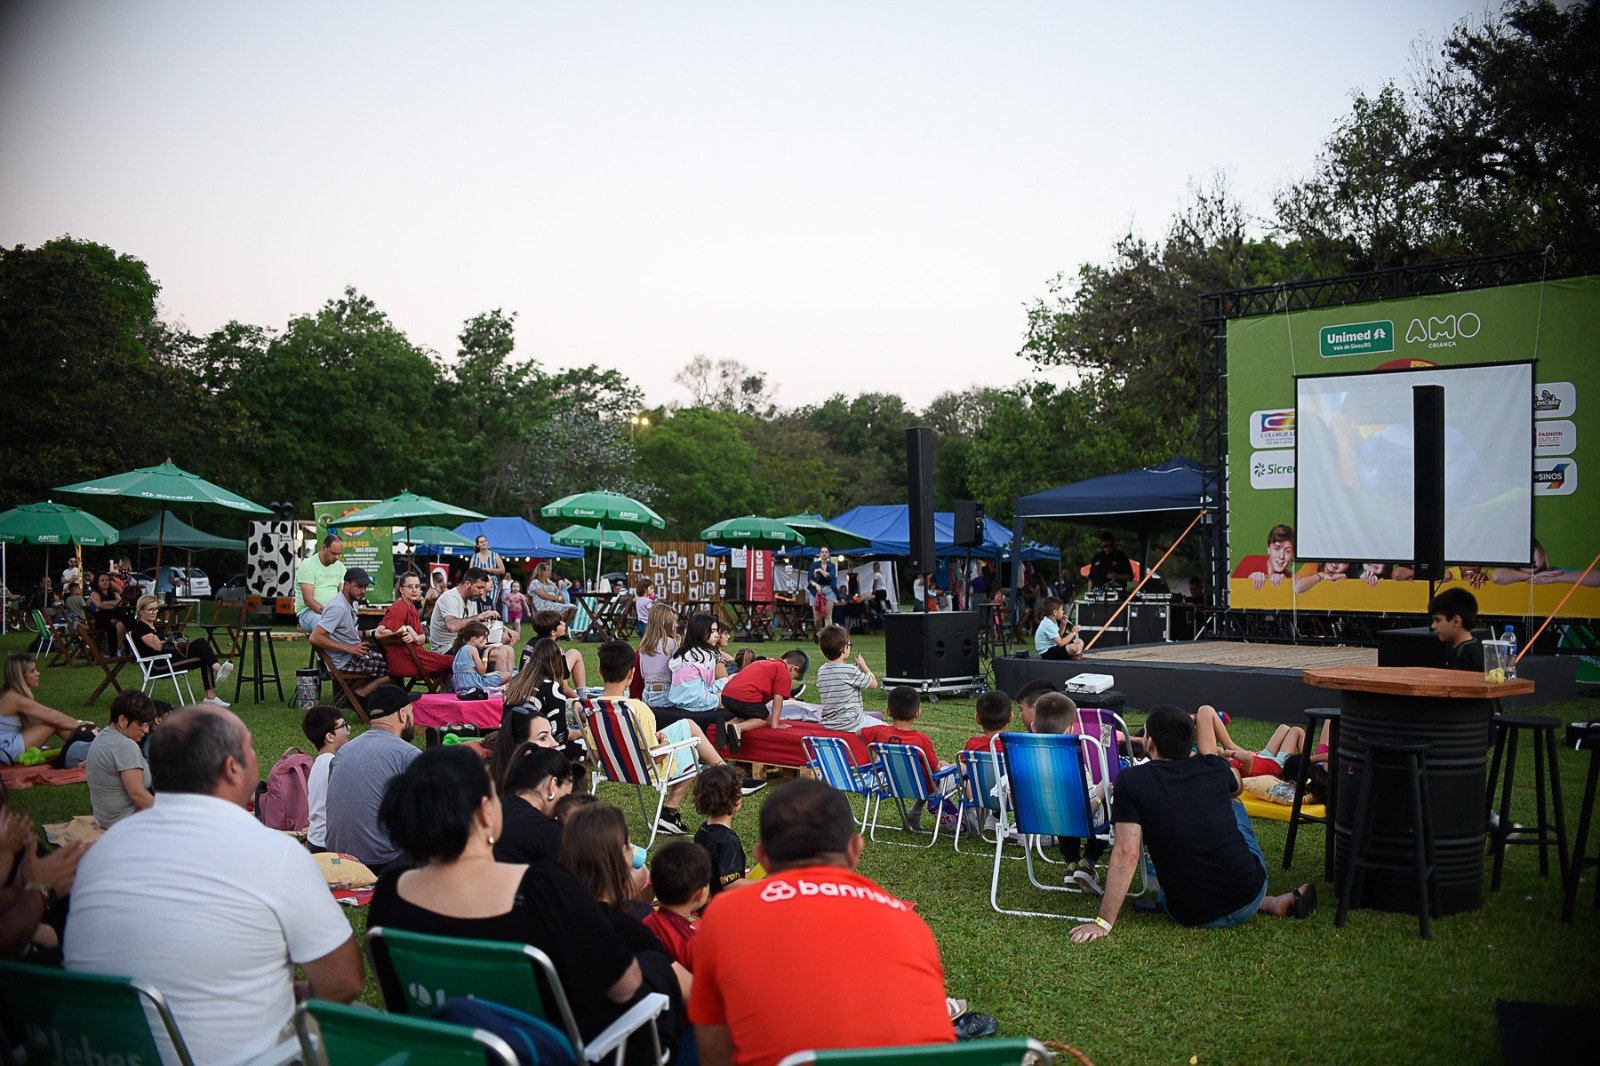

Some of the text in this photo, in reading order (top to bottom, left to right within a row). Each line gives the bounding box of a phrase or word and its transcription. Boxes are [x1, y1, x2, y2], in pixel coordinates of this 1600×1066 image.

[1405, 312, 1481, 344] AMO
[1327, 329, 1371, 344] Unimed
[1429, 341, 1457, 349] CRIANÇA
[1538, 472, 1563, 481] SINOS
[755, 549, 764, 580] BREC
